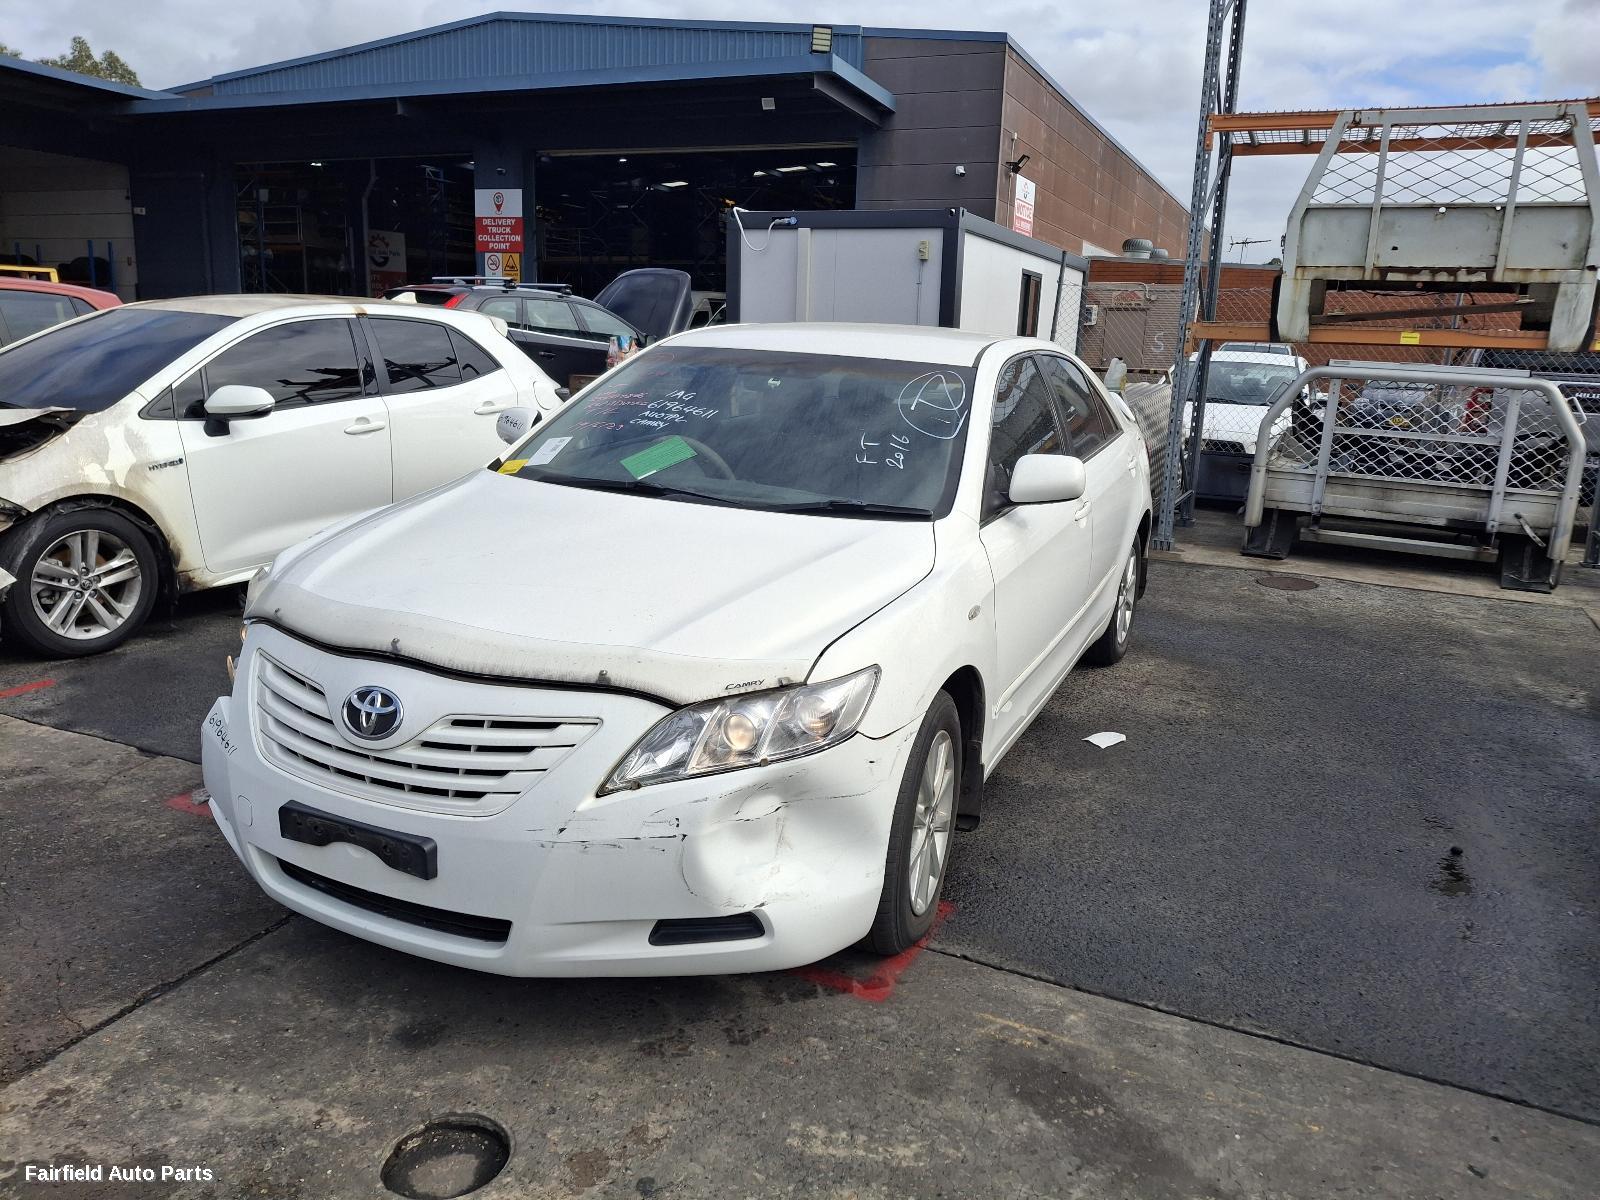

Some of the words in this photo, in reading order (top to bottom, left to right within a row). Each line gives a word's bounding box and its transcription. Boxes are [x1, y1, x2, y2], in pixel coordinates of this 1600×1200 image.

[482, 218, 516, 226] DELIVERY
[478, 234, 521, 242] COLLECTION
[1574, 391, 1600, 399] HILU
[647, 399, 719, 419] 61964611
[885, 433, 911, 470] 2016
[725, 678, 766, 690] CAMRY
[209, 712, 238, 756] 61964611
